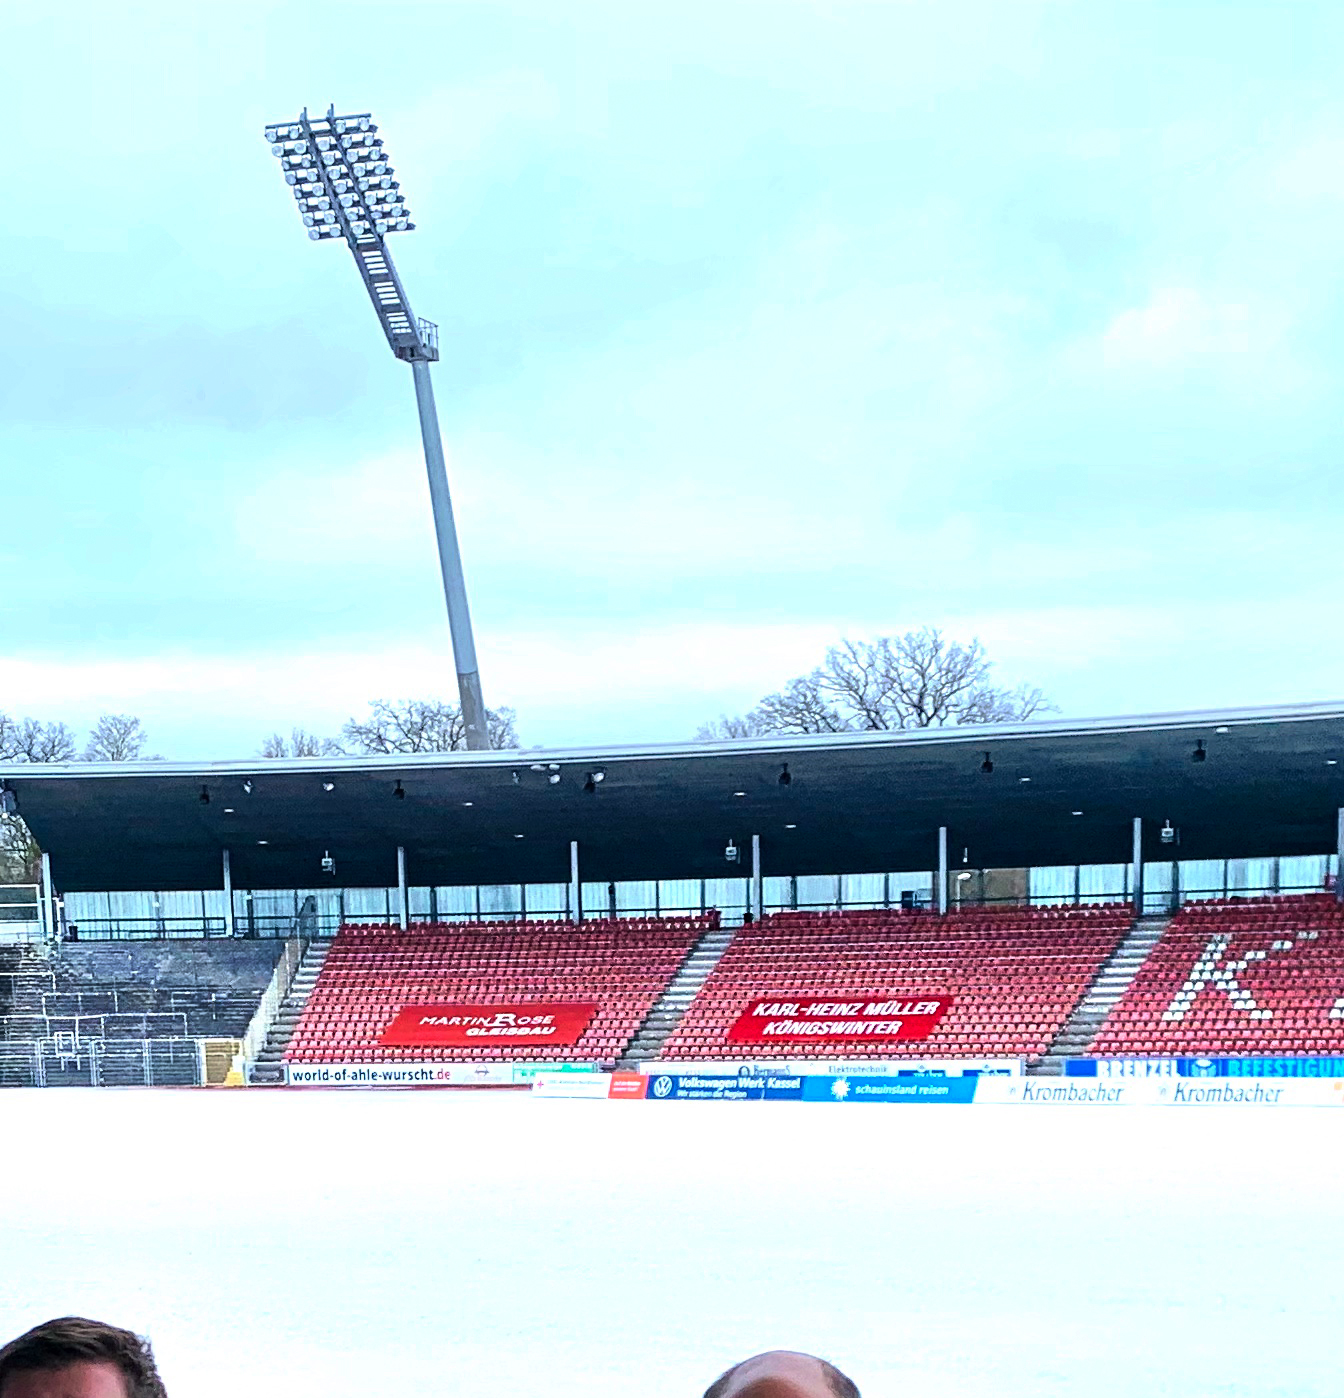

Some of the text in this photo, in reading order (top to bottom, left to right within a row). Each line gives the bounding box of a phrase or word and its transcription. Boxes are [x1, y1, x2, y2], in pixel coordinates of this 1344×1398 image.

[752, 1000, 940, 1016] KARL-HEINZ MÜLLER
[420, 1013, 555, 1027] MARTIN ROSE
[762, 1019, 902, 1035] KÖNIGSWINTER
[292, 1068, 451, 1081] world-of-ahle-wurscht.de
[1097, 1059, 1180, 1077] BRENZEL
[678, 1077, 800, 1090] Volkswagen Werk Kassel
[855, 1084, 948, 1095] schauinsland reisen
[1023, 1081, 1124, 1101] Krombacher
[1174, 1082, 1285, 1102] Krombacher
